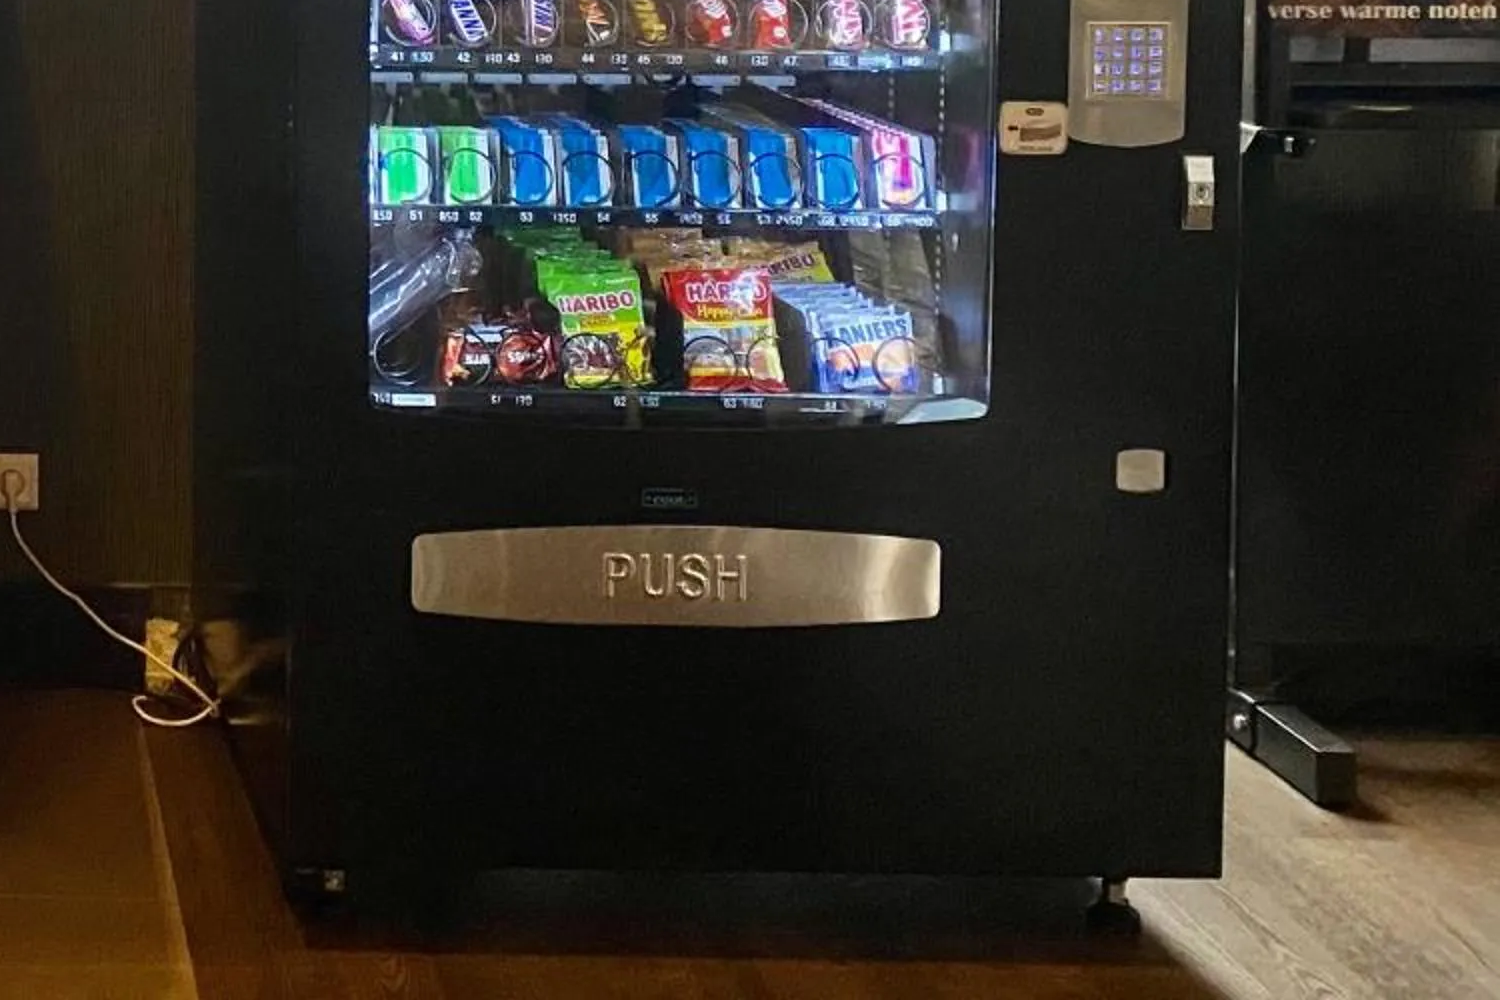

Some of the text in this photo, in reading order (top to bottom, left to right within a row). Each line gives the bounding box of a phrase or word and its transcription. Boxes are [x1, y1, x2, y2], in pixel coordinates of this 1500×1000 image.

[1267, 3, 1498, 19] verse warme noten
[761, 253, 815, 276] ARIBO
[557, 290, 635, 313] HARIBO
[685, 281, 766, 303] HARO
[602, 551, 748, 602] PUSH
